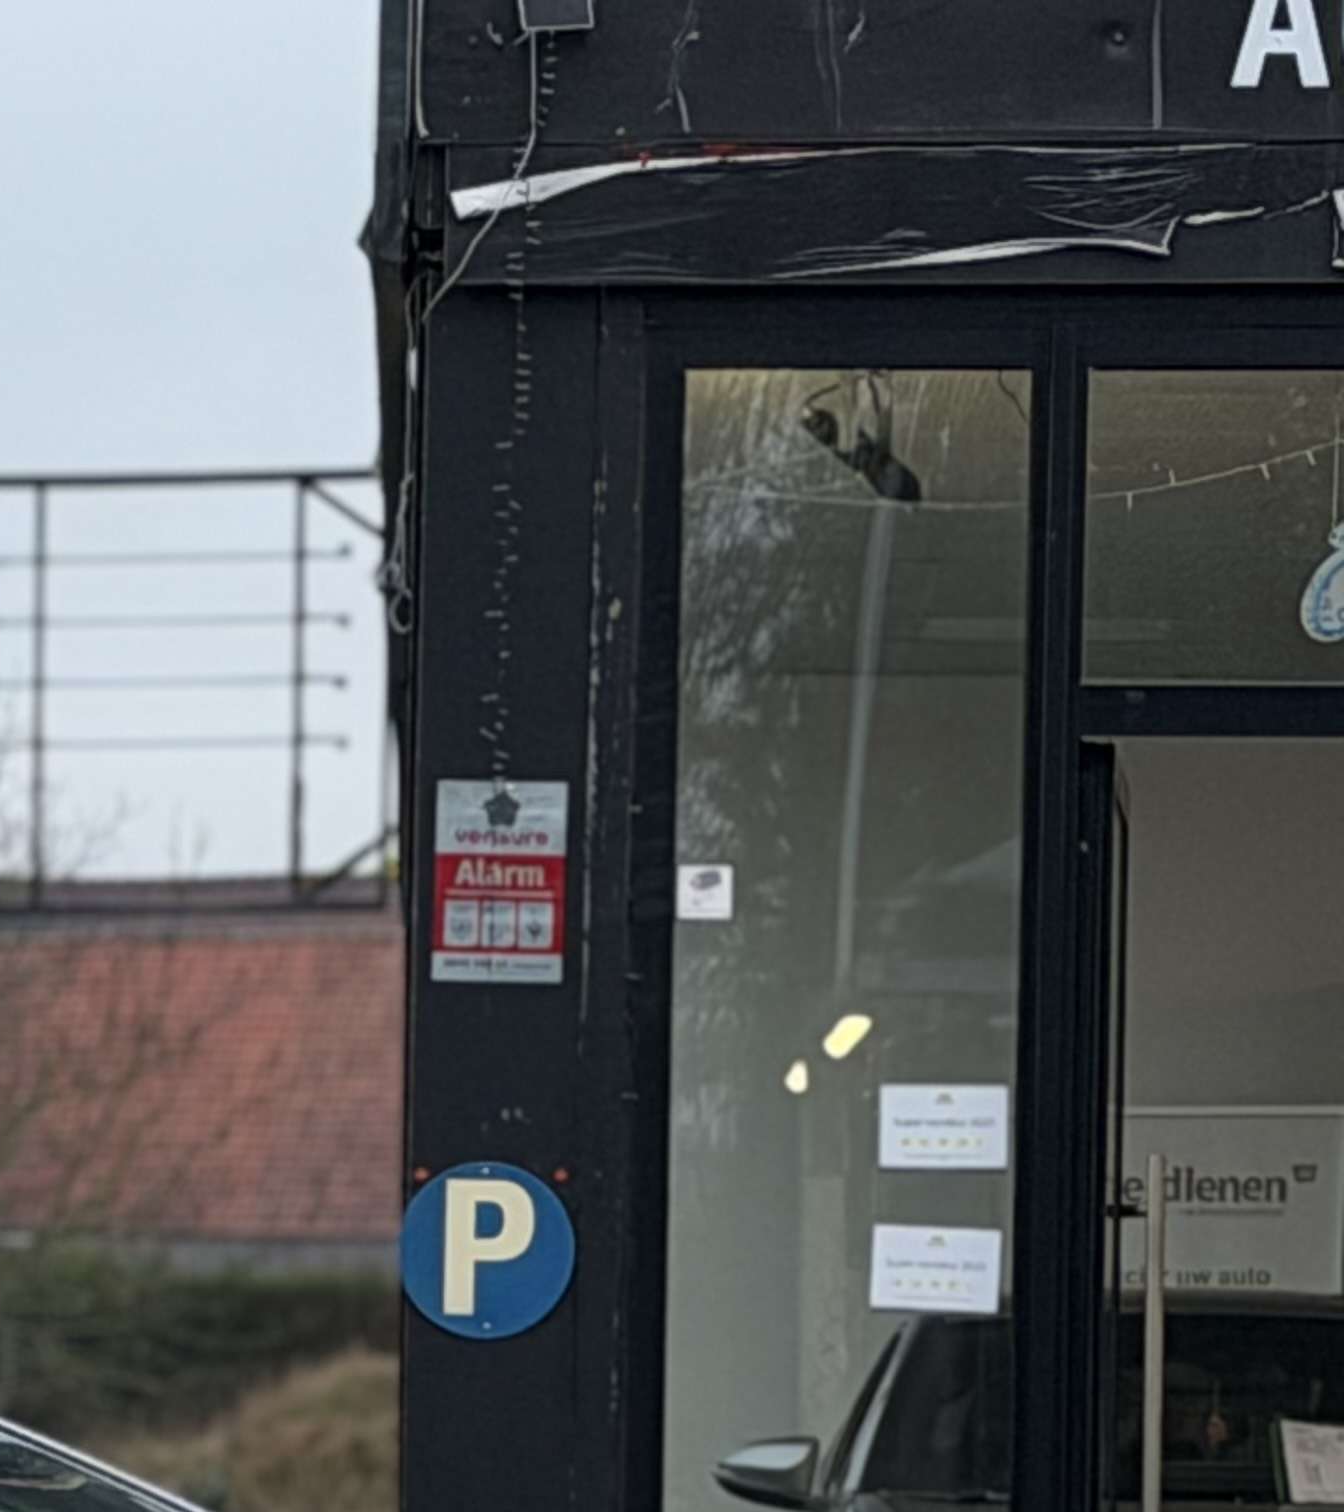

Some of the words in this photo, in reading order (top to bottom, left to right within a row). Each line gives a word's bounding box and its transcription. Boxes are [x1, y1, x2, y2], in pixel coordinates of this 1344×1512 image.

[1230, 0, 1344, 88] A
[455, 857, 546, 887] Alarm
[443, 1178, 535, 1316] P
[1217, 1266, 1272, 1286] auto
